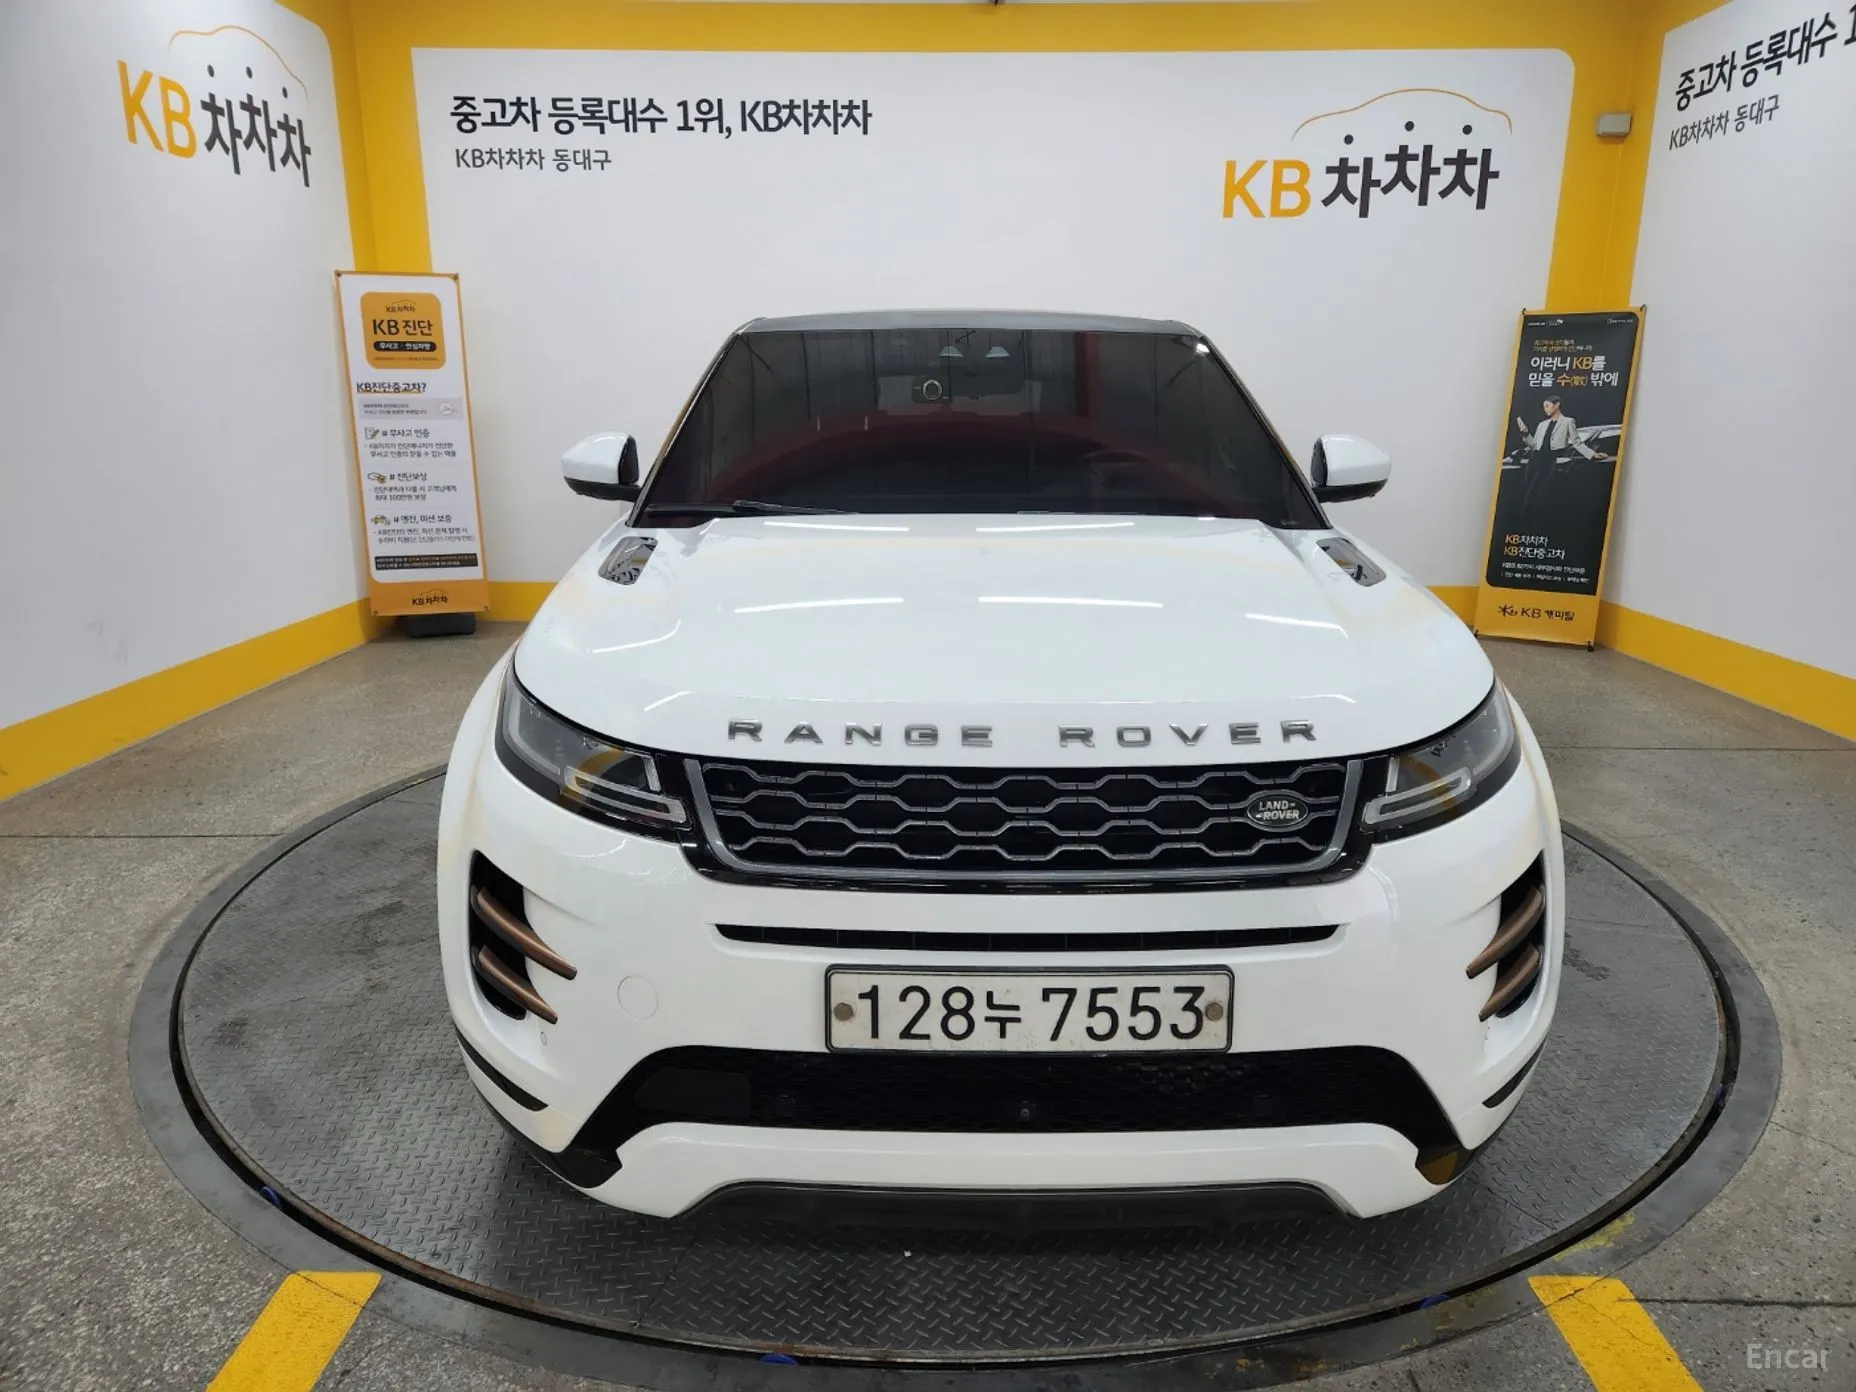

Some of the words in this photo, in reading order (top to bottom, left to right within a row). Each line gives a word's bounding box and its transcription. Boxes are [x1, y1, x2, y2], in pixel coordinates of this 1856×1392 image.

[1675, 51, 1737, 111] 중고차
[1740, 12, 1838, 88] 등록대수
[450, 96, 541, 134] 중고차
[548, 97, 668, 135] 등록대수
[676, 98, 732, 139] 1위,
[740, 98, 873, 135] KB차차차
[1669, 110, 1729, 150] KB차차차
[1734, 94, 1780, 132] 동대구
[455, 148, 545, 170] KB차차차
[552, 148, 612, 172] 동대구
[402, 319, 434, 336] 진단
[1530, 356, 1570, 371] 이러니
[1572, 355, 1606, 371] KB를
[356, 382, 427, 393] KB진단중고차?
[1528, 372, 1554, 387] 믿을
[1590, 372, 1619, 387] 밖에
[1504, 545, 1565, 560] KB진단중고차
[727, 719, 993, 747] RANGE
[1058, 719, 1318, 748] ROVER
[1041, 985, 1207, 1042] 7553
